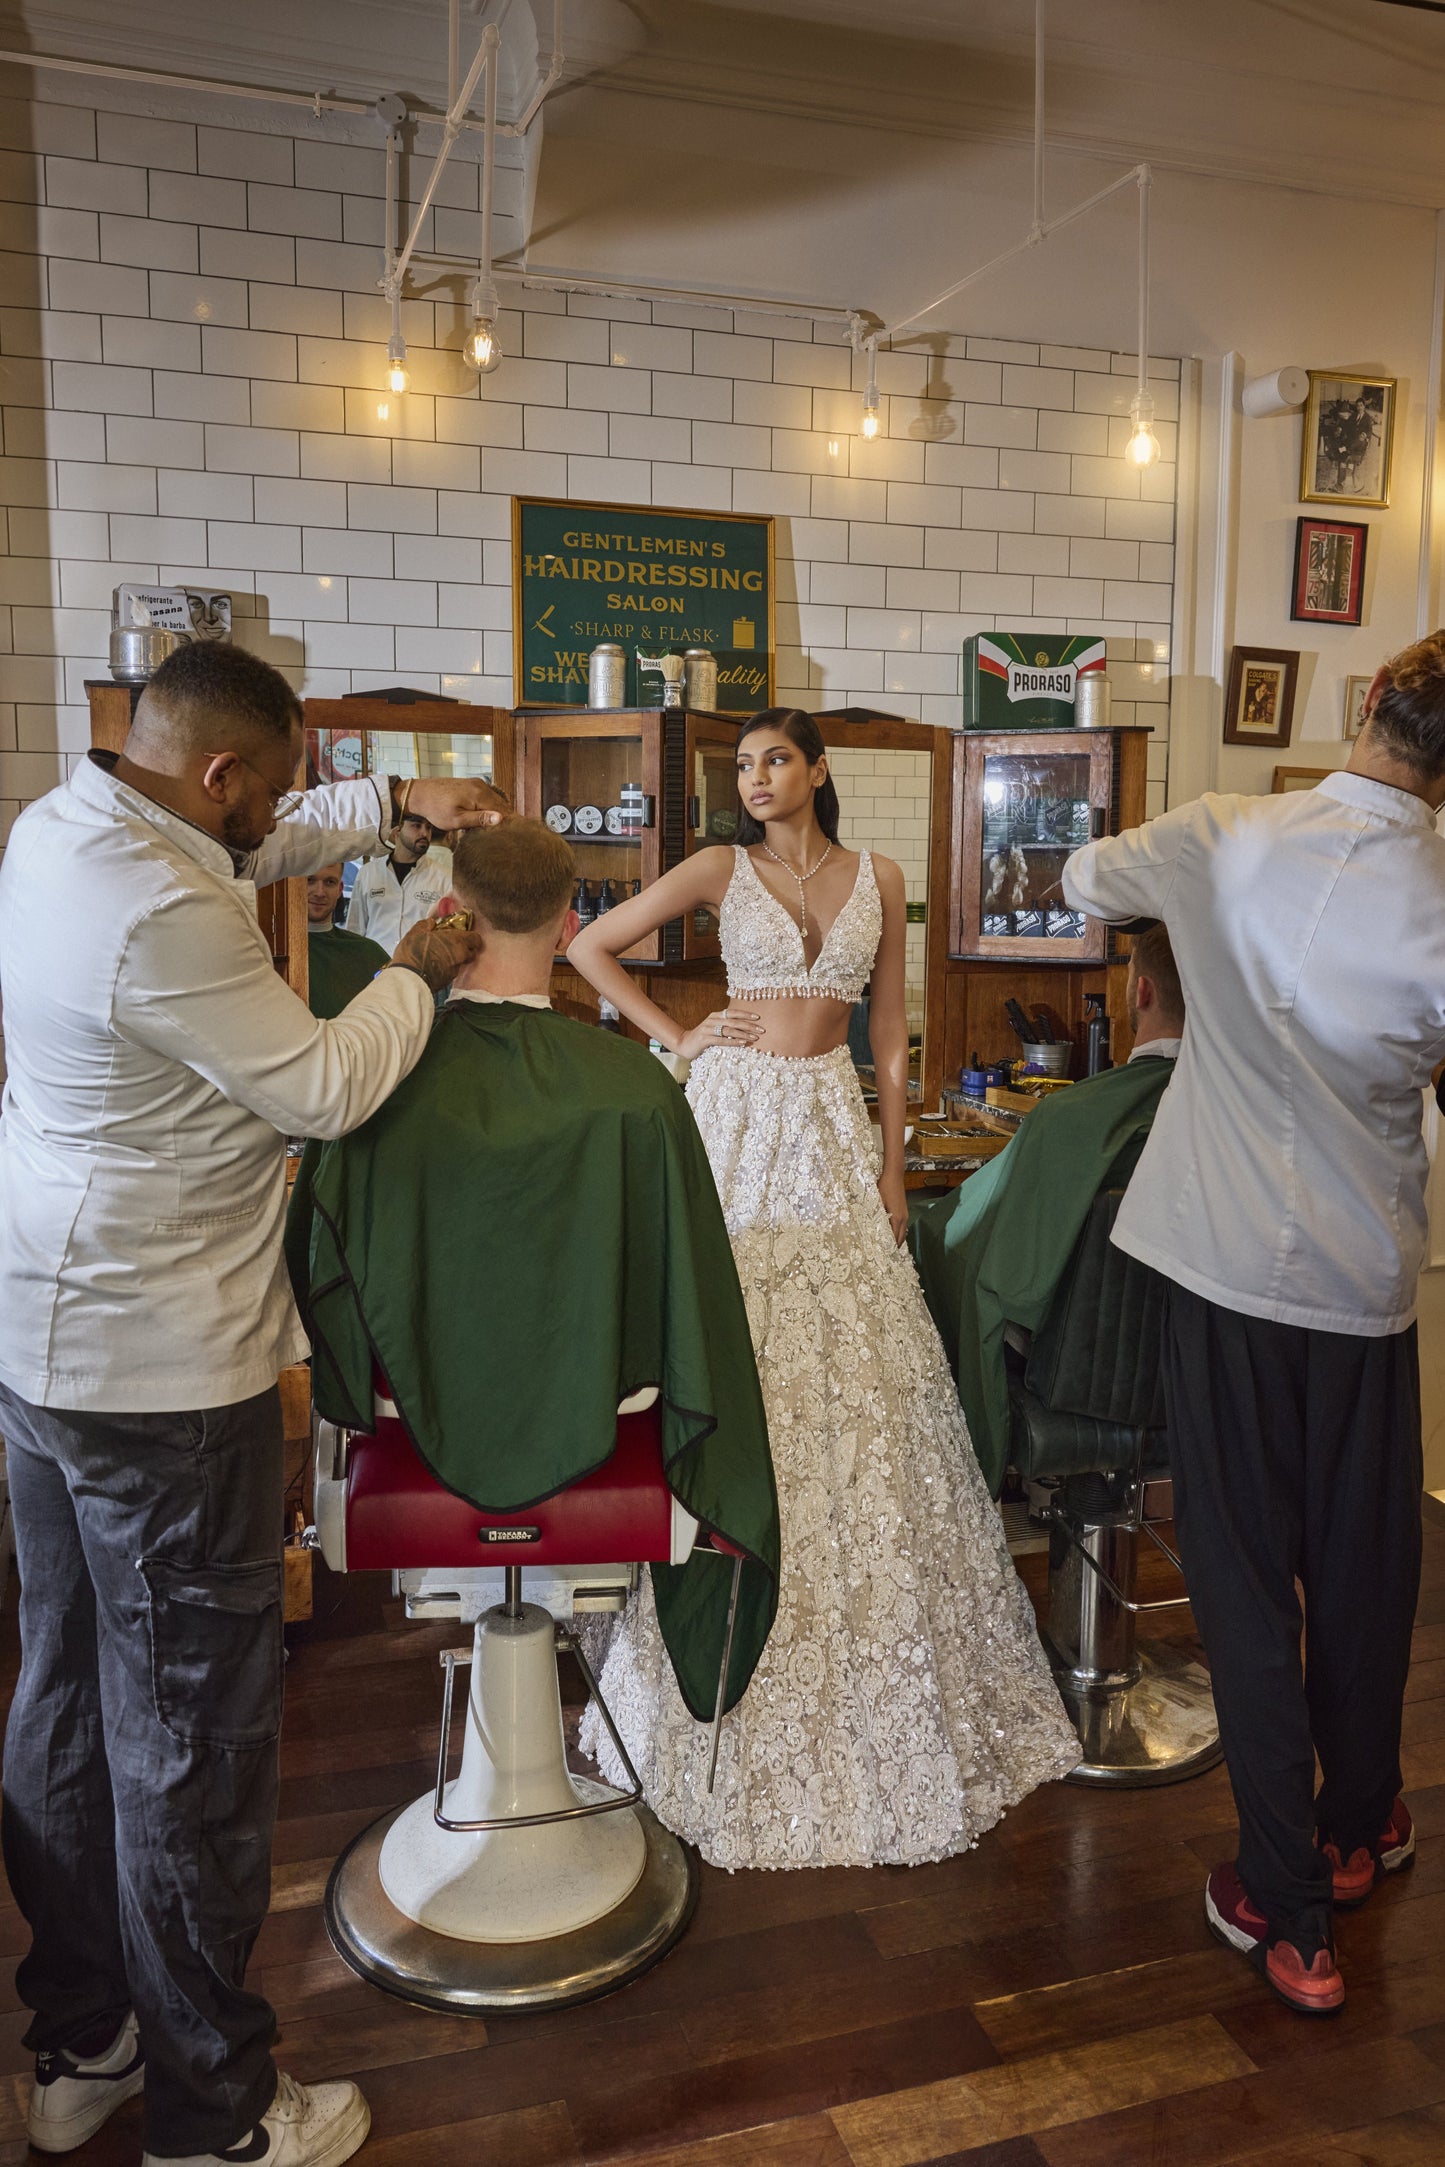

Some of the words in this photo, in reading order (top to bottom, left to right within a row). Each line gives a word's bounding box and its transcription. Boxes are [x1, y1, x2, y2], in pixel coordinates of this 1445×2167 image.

[563, 531, 726, 558] GENTLEMEN'S
[524, 554, 763, 592] HAIRDRESSING
[149, 606, 183, 616] asana
[607, 593, 685, 614] SALON
[574, 621, 634, 638] SHARP
[641, 625, 652, 640] &
[659, 626, 716, 643] FLASK
[554, 651, 590, 668] WE
[642, 660, 661, 669] PRORAS
[530, 665, 589, 685] SHAV
[716, 664, 767, 696] ality
[1013, 671, 1071, 693] PRORASO
